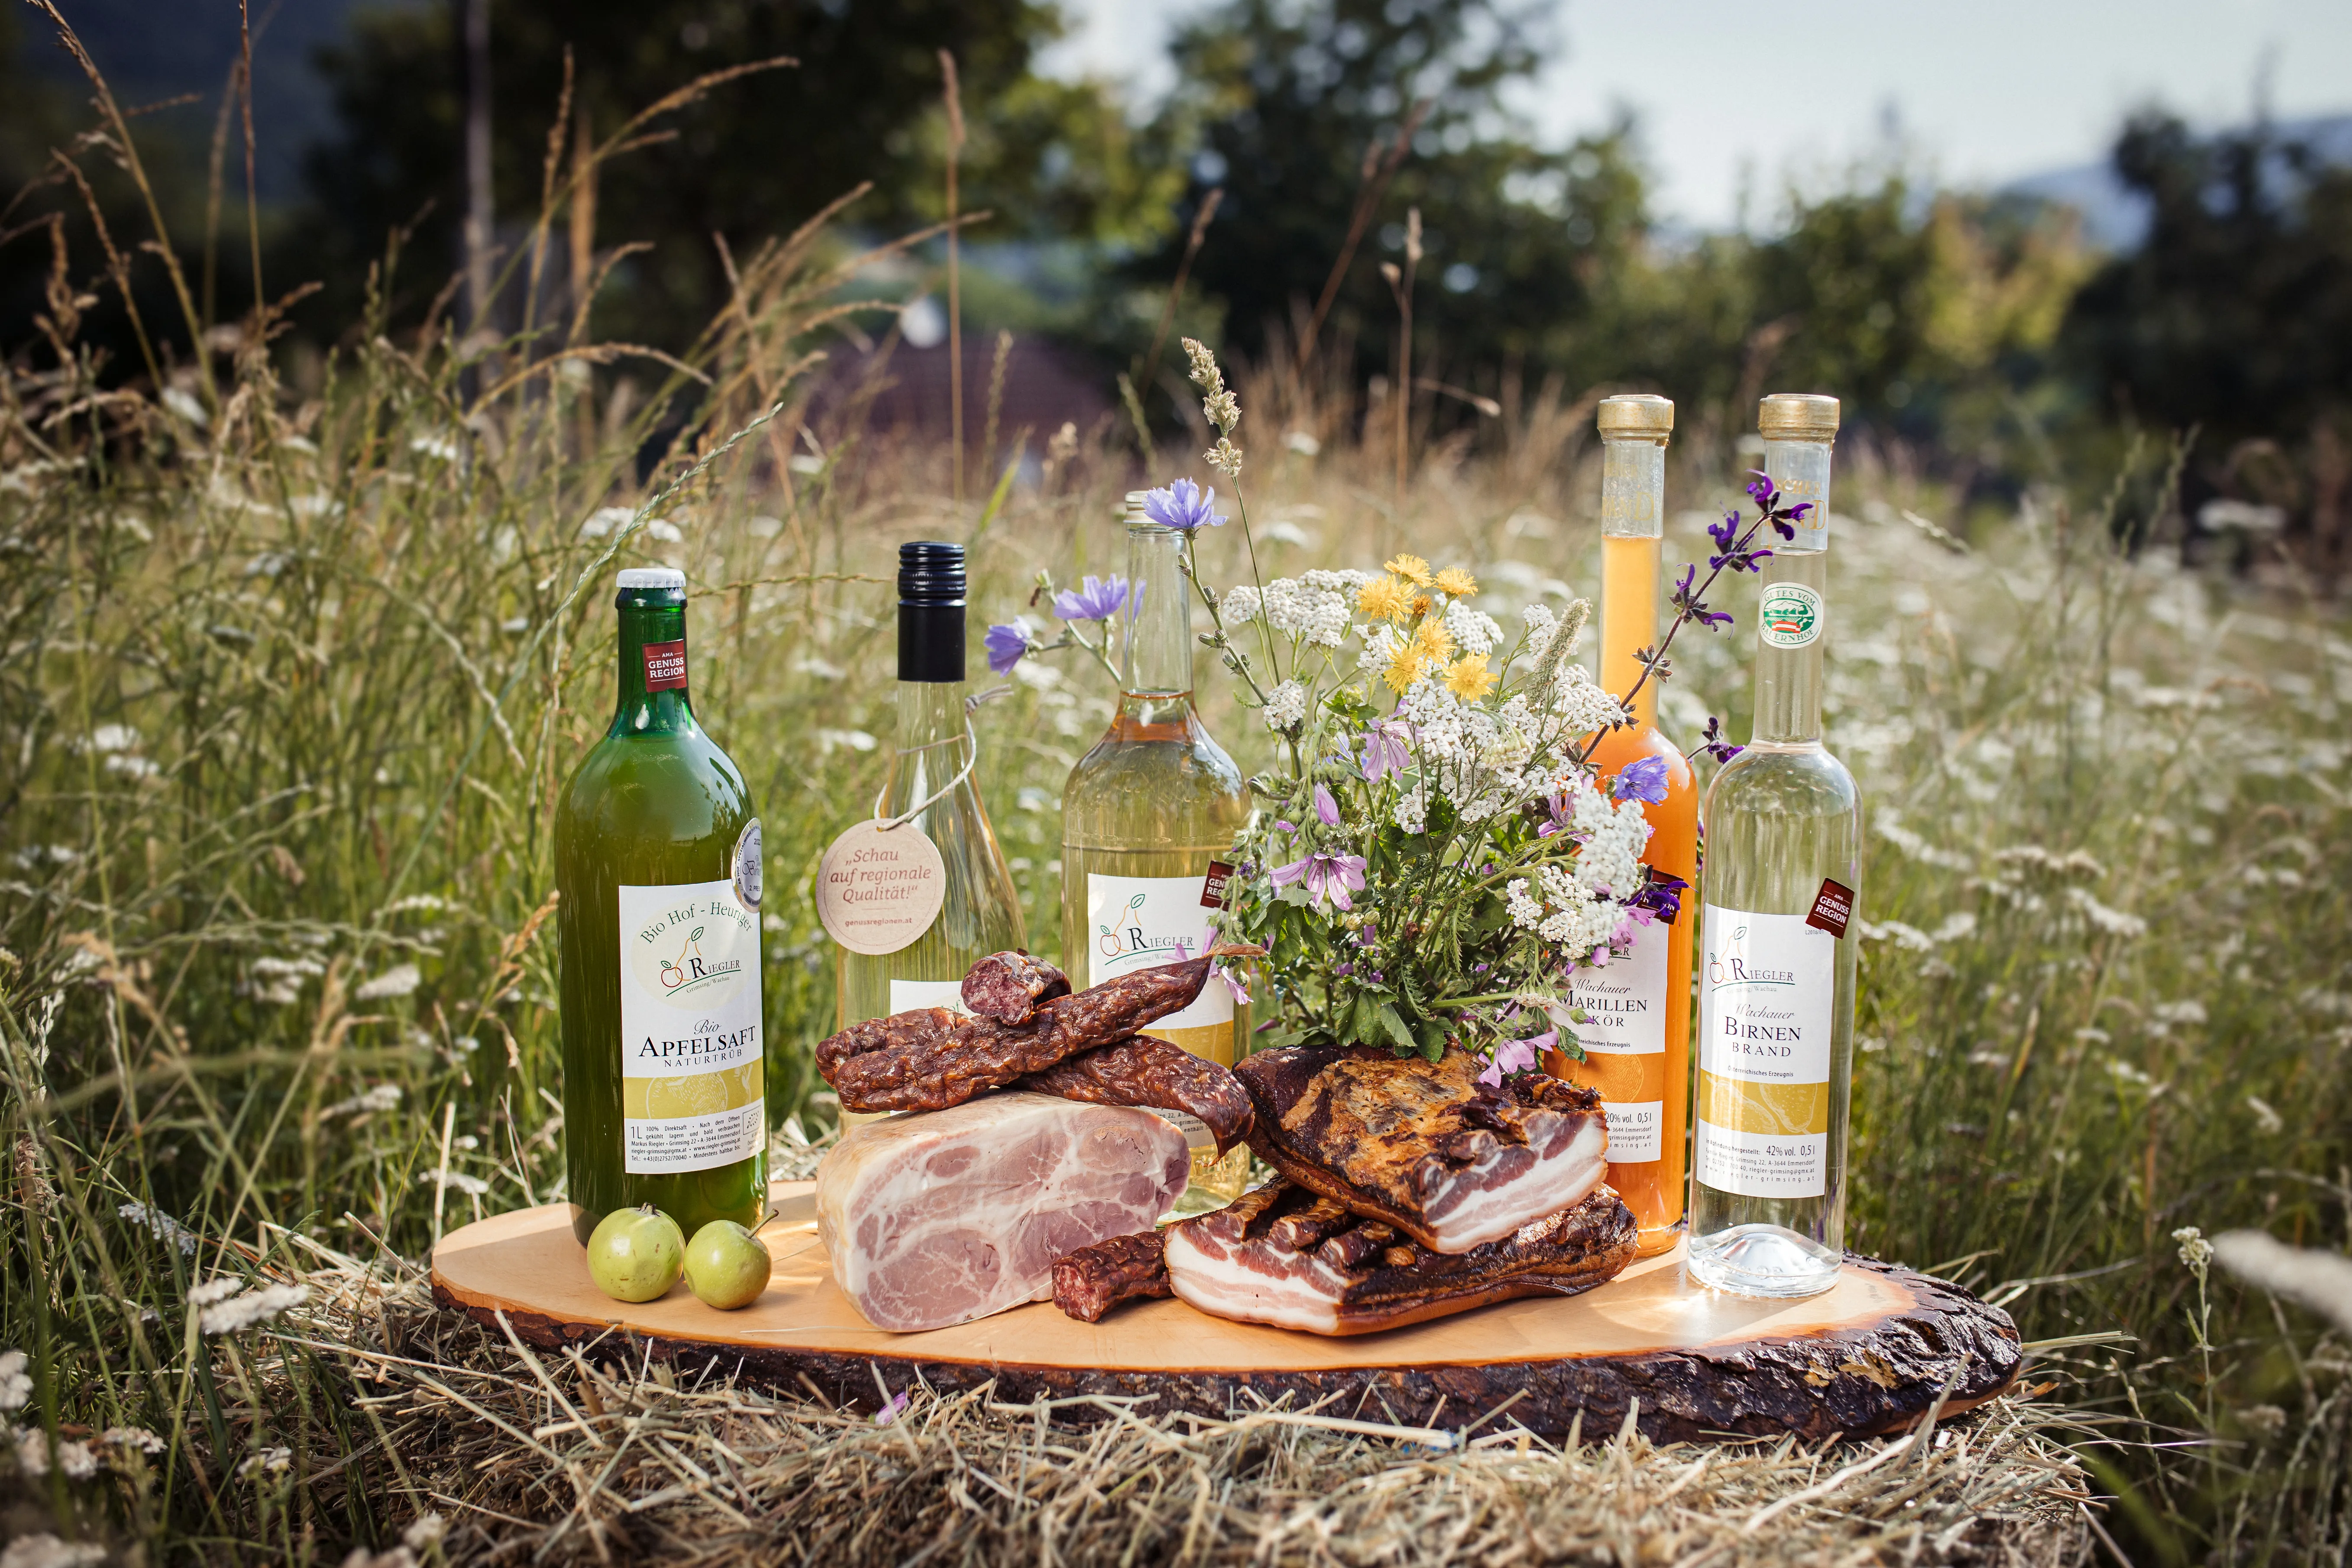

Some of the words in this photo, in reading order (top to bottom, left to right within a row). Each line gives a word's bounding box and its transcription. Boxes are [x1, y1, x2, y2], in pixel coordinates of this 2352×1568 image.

[1764, 590, 1794, 601] GUTES
[1798, 592, 1816, 606] VOM
[648, 657, 684, 669] GENUSS
[650, 666, 684, 678] REGION
[831, 868, 857, 886] auf
[860, 865, 931, 885] regionale
[1209, 878, 1225, 888] GEN
[1819, 896, 1849, 915] GENUSS
[1815, 904, 1847, 924] REGION
[641, 922, 665, 944] Bio
[667, 904, 695, 925] Hof
[711, 902, 752, 932] Heuriger
[845, 918, 912, 927] genussregionen.at
[1124, 953, 1165, 965] Grimsing/Wa
[686, 976, 730, 993] Grimsing/Wachau
[1575, 978, 1632, 994] Wachauer
[1727, 985, 1777, 993] Grmsing/Wachau
[1735, 1004, 1795, 1019] Wachauer
[694, 1018, 721, 1035] Bio
[1592, 1015, 1624, 1027] KÖR
[1732, 1042, 1791, 1057] BRAND
[664, 1049, 742, 1067] NATURTRÜB
[1728, 1065, 1767, 1076] Öterreichisches
[1606, 1112, 1621, 1123] 20%
[1622, 1114, 1633, 1123] vol.
[718, 1123, 740, 1132] verbrauchen
[718, 1129, 741, 1139] Emmersdorf
[693, 1137, 741, 1151] www.riegler-grimsing.at
[1732, 1146, 1760, 1155] hergestellt:
[1766, 1145, 1783, 1156] 42%
[1784, 1147, 1796, 1156] vol.
[693, 1150, 718, 1158] Mindestens
[1719, 1152, 1734, 1161] Rieger,
[1736, 1157, 1757, 1166] Grimsing
